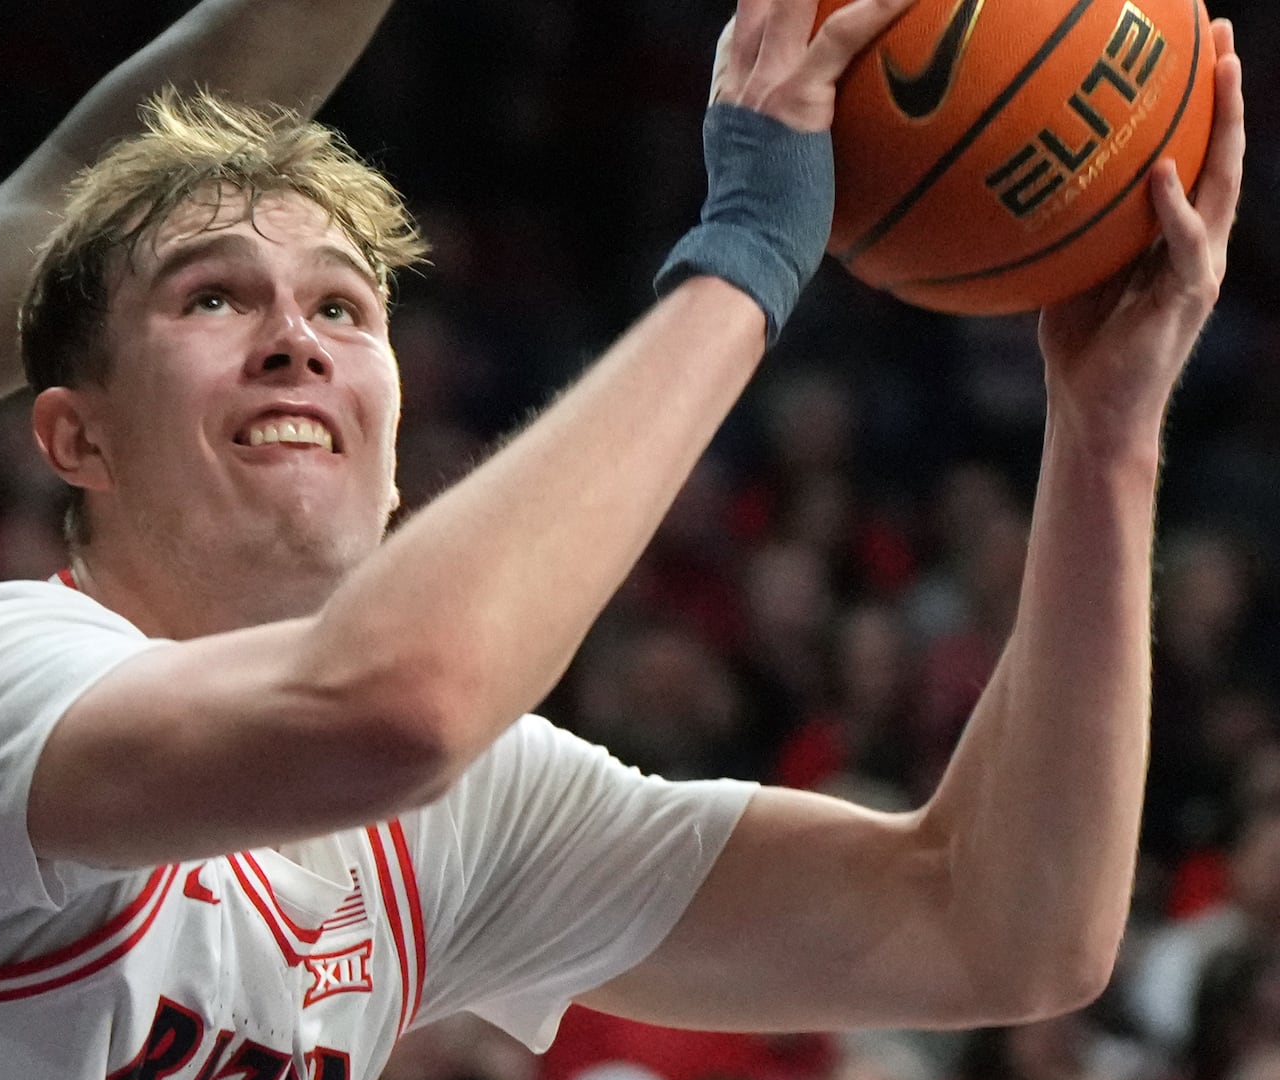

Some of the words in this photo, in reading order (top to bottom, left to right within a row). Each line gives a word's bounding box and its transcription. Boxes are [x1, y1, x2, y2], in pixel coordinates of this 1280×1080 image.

[984, 1, 1167, 218] ELITE
[1024, 50, 1178, 232] HAMPIONS
[306, 948, 370, 1001] XII
